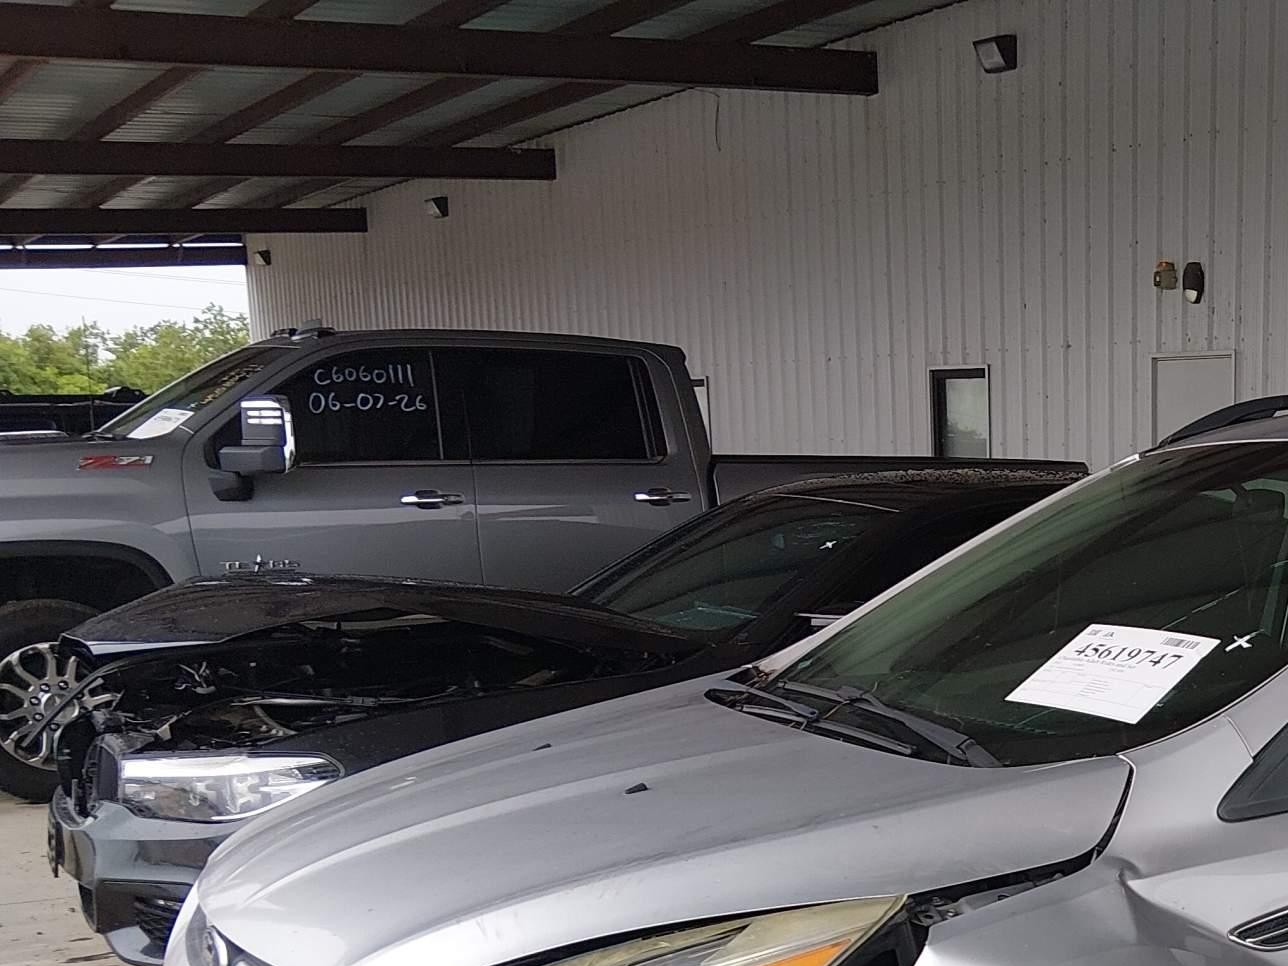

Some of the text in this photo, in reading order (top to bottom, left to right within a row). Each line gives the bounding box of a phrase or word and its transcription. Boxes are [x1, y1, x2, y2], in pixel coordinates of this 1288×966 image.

[308, 392, 428, 414] 06-07-26
[75, 455, 154, 471] Z71
[1074, 643, 1184, 670] 45619747
